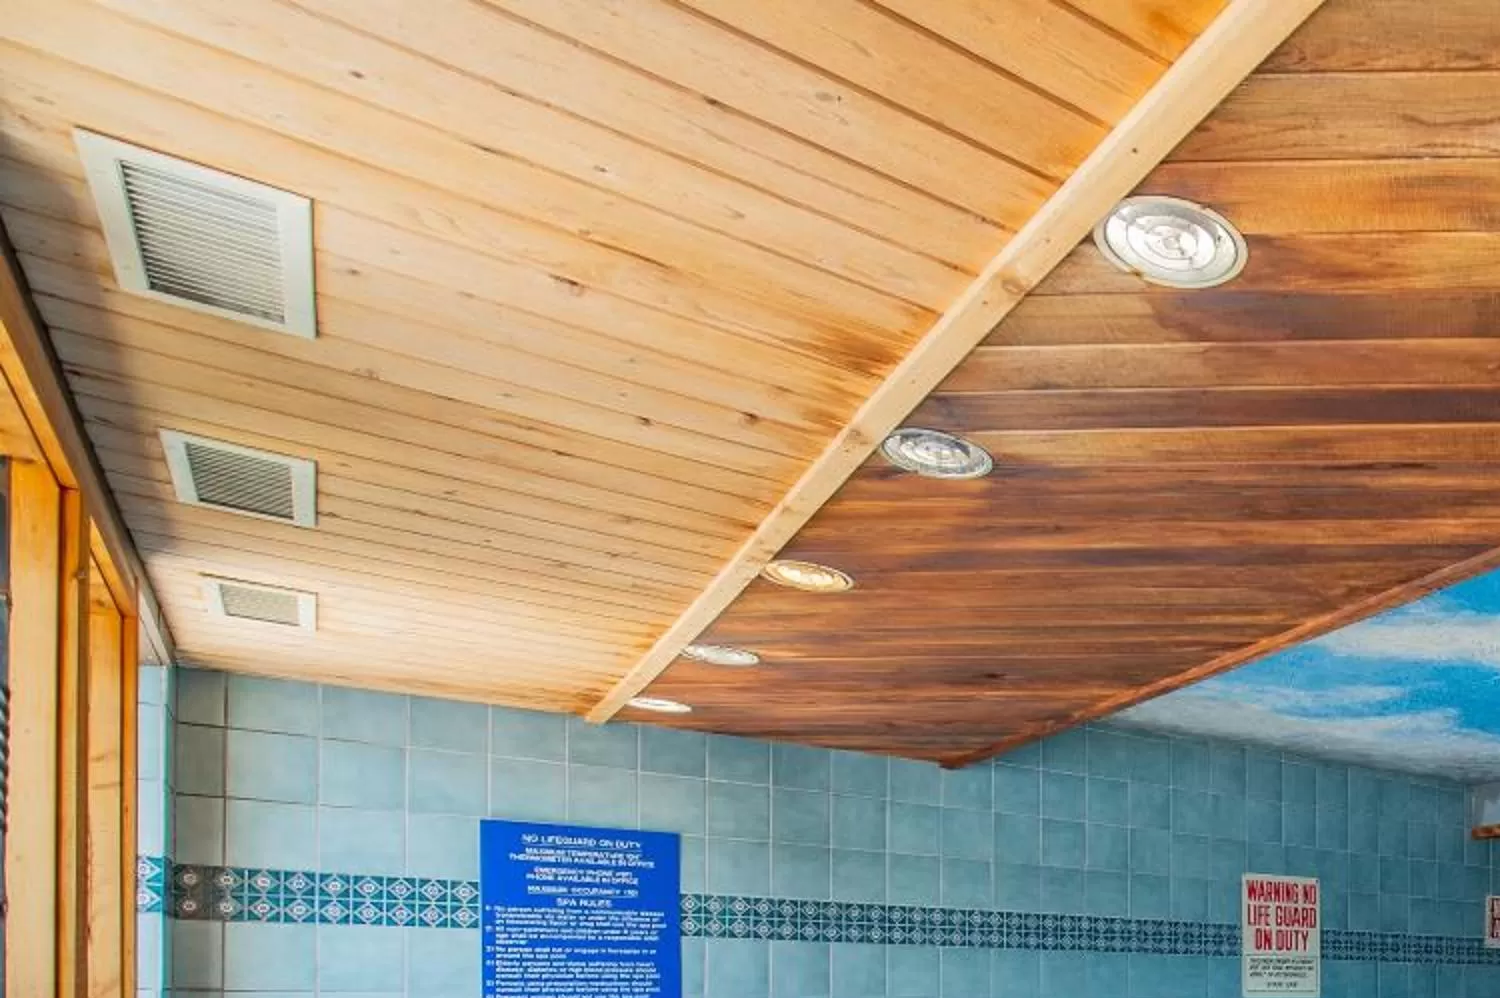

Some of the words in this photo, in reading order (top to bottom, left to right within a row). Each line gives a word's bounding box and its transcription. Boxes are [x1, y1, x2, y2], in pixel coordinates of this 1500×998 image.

[521, 832, 538, 843] NO
[615, 839, 642, 849] DUTY
[1247, 880, 1299, 905] WARNING
[1302, 884, 1317, 906] NO
[1247, 904, 1271, 926] LIFE
[1275, 906, 1317, 929] GUARD
[1255, 928, 1273, 951] ON
[1276, 930, 1309, 952] DUTY
